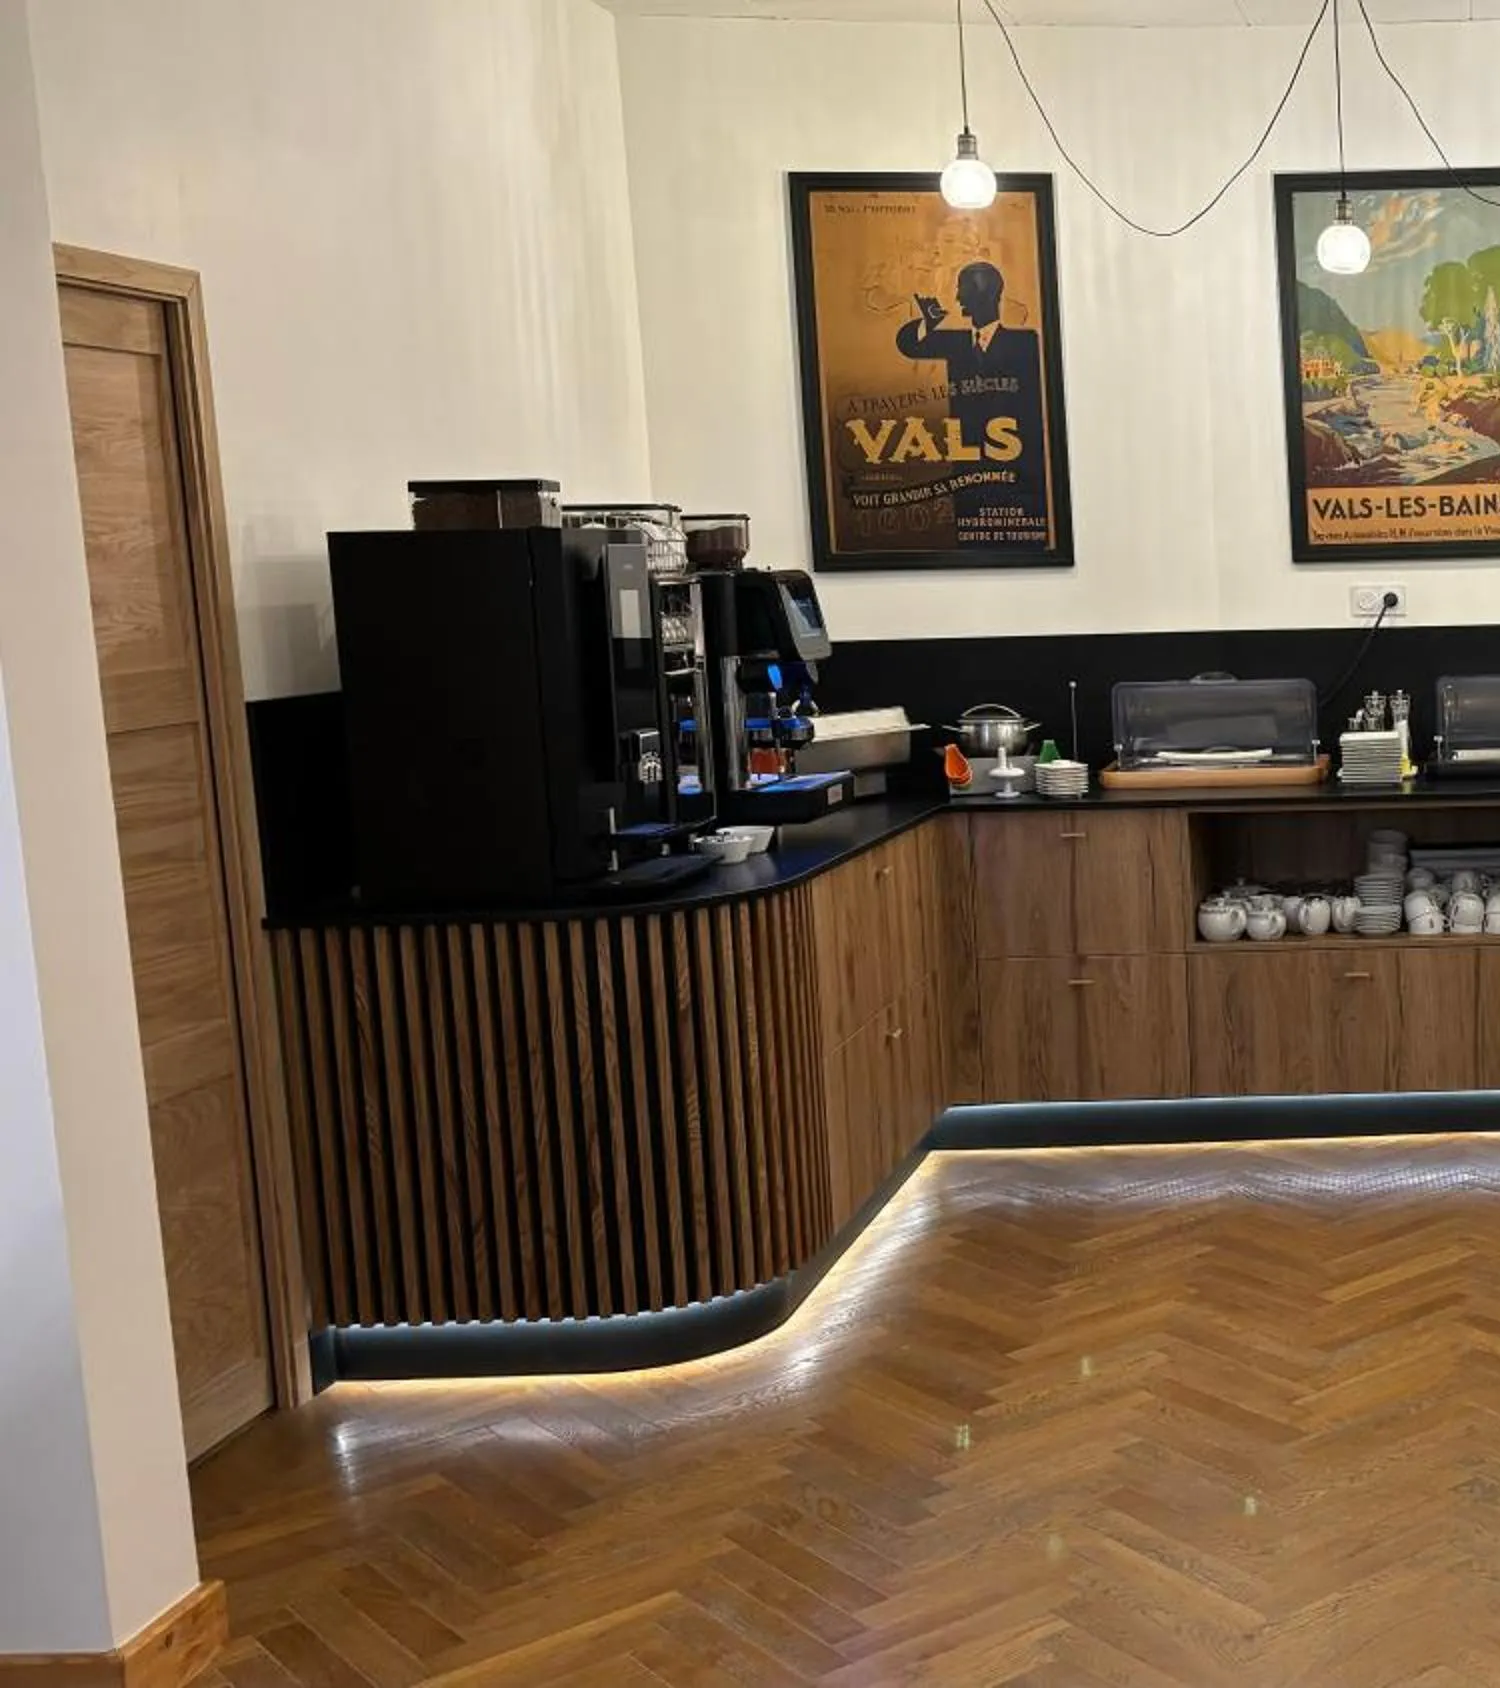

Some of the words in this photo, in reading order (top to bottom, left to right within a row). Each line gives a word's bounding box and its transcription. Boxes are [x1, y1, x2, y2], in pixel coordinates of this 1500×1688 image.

[845, 416, 1023, 464] VALS
[853, 493, 880, 505] VOIT
[883, 485, 933, 505] GRANDIR
[979, 507, 1025, 517] STATION
